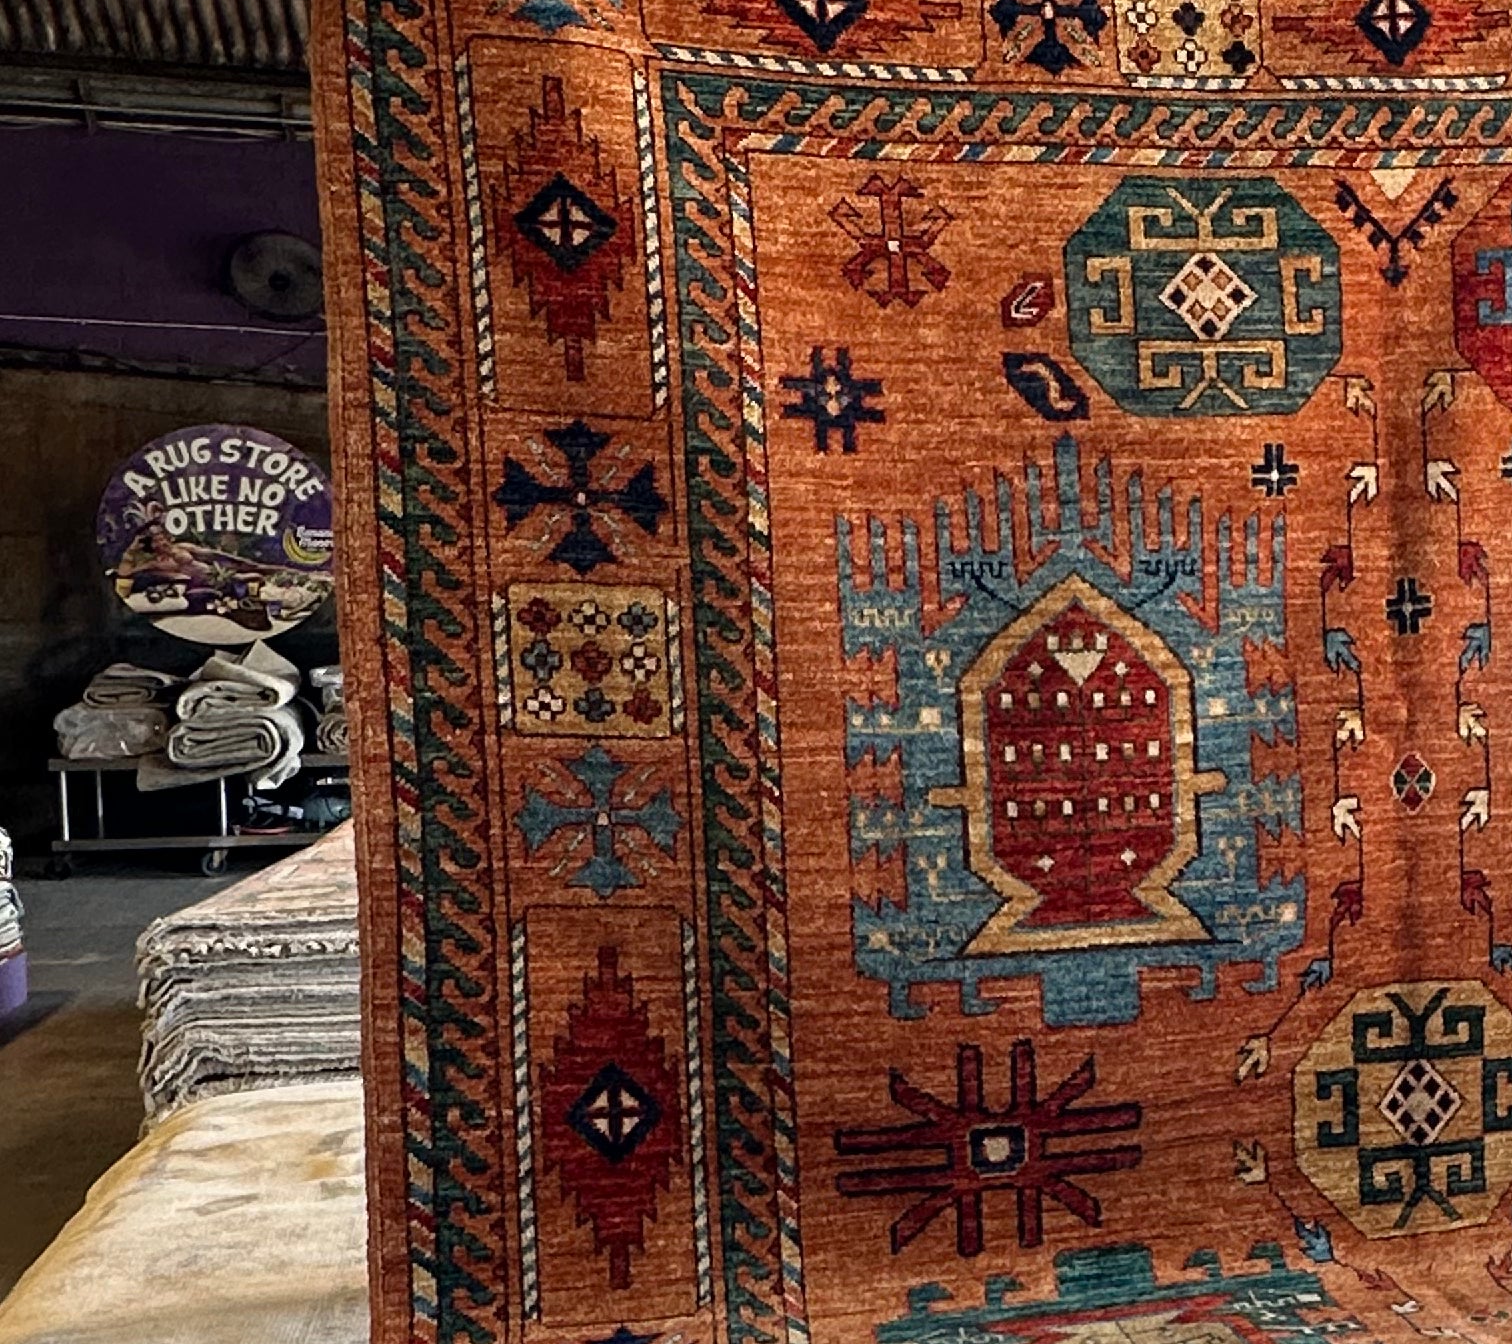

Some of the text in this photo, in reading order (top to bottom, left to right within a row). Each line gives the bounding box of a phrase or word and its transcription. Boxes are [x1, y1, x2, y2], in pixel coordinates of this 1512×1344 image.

[123, 437, 324, 501] A RUG STORE
[161, 474, 286, 506] LIKE NO
[165, 504, 279, 536] OTHER
